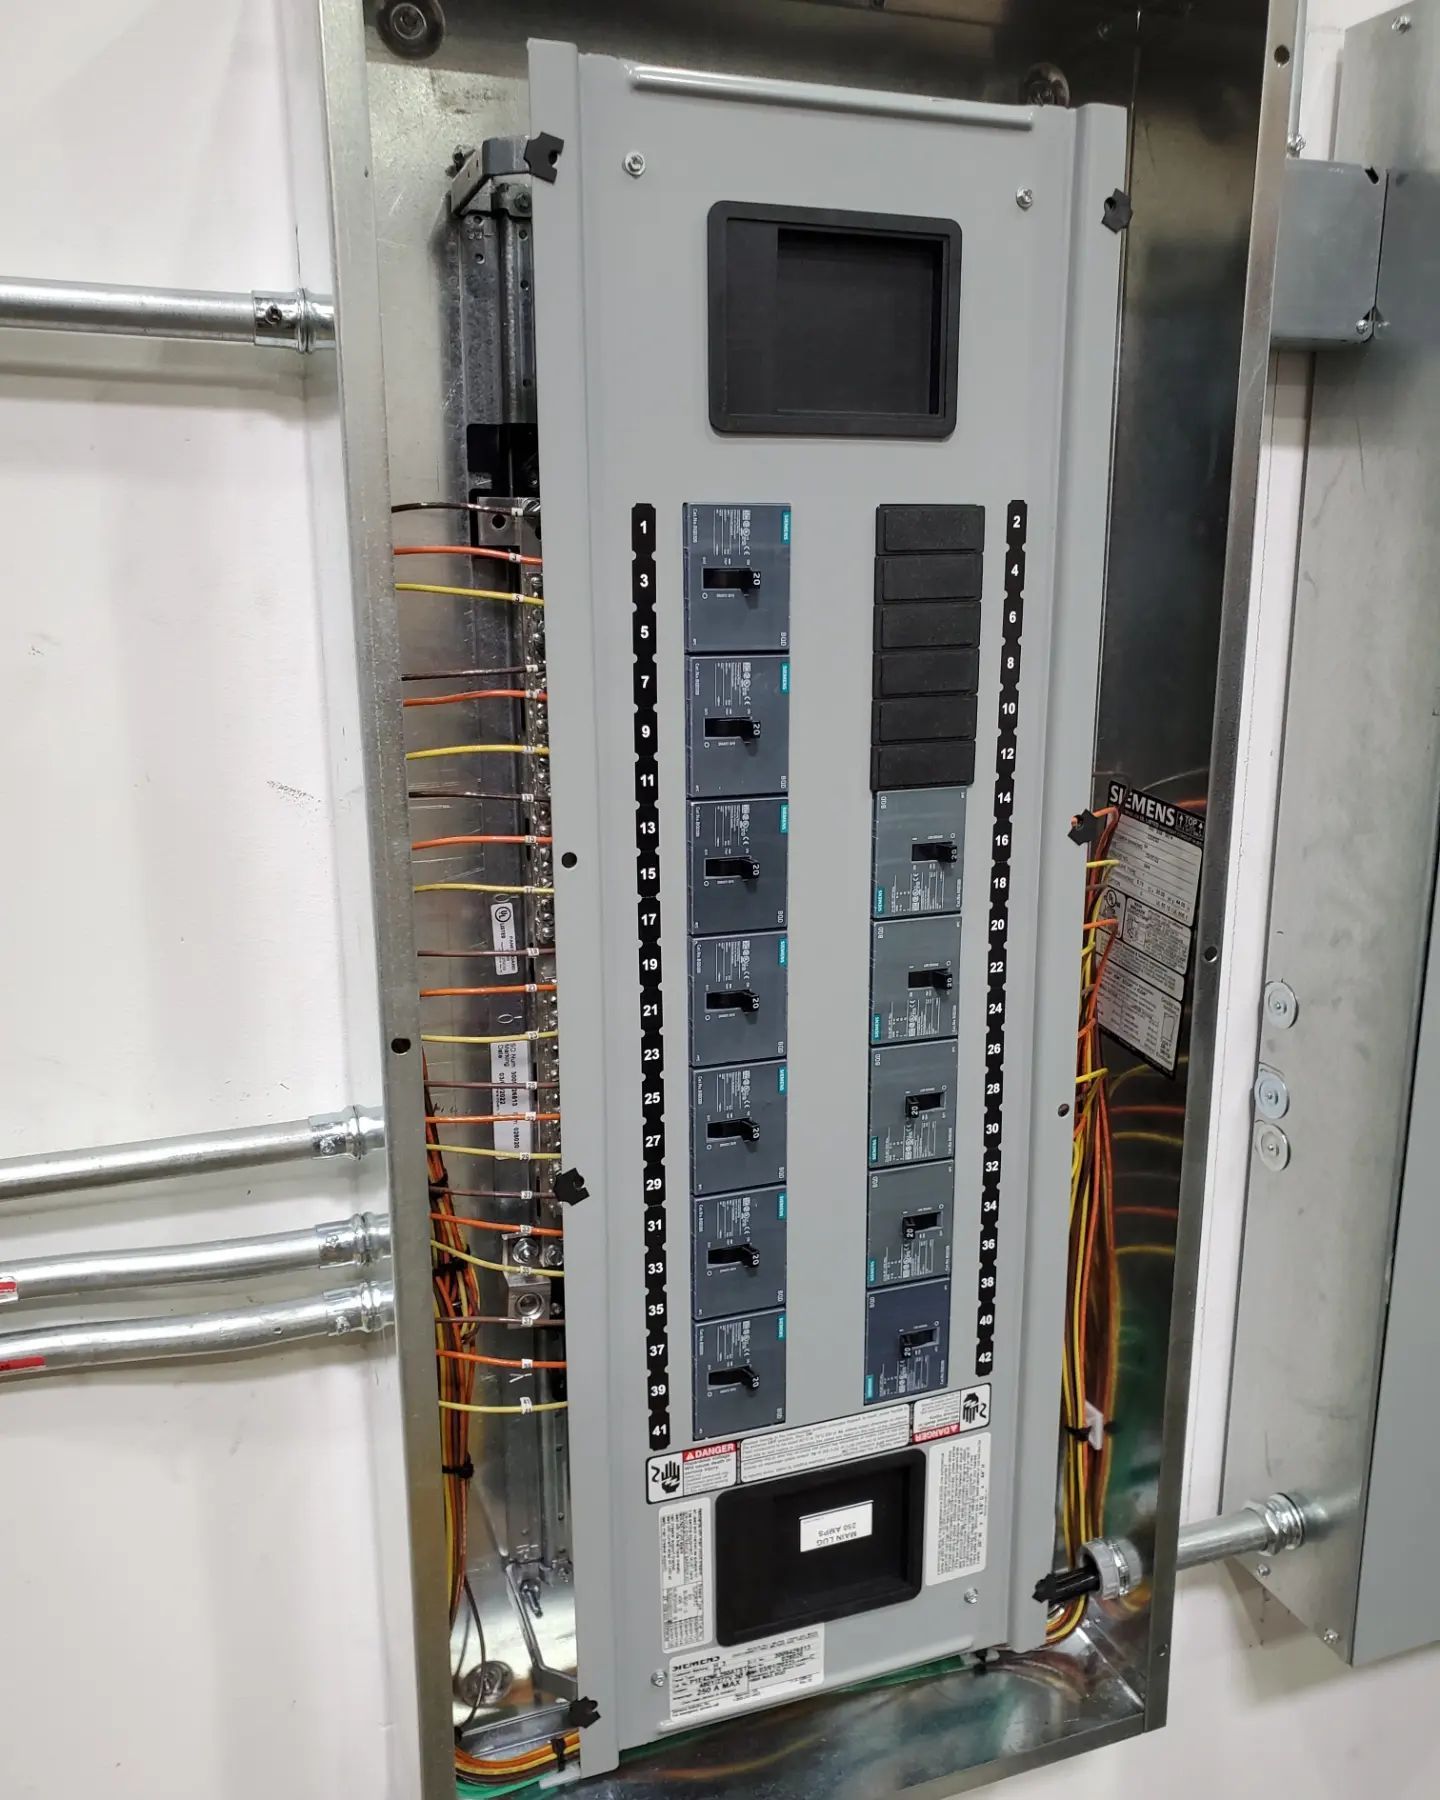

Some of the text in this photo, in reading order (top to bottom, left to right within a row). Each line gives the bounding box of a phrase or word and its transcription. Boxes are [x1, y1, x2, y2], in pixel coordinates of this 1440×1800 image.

[640, 520, 647, 534] 1
[1013, 515, 1021, 528] 2
[1011, 564, 1019, 576] 4
[640, 574, 649, 588] 3
[753, 573, 760, 585] 20
[1009, 610, 1016, 624] 6
[640, 625, 649, 639] 5
[1007, 656, 1014, 669] 8
[641, 675, 650, 688] 7
[1002, 702, 1016, 715] 10
[642, 725, 650, 738] 9
[754, 724, 760, 735] 20
[1000, 747, 1014, 760] 12
[640, 774, 654, 787] 11
[998, 792, 1011, 804] 14
[640, 821, 656, 834] 13
[995, 834, 1009, 846] 16
[640, 867, 656, 880] 15
[753, 864, 759, 875] 20
[993, 877, 1006, 889] 18
[641, 913, 657, 926] 17
[990, 919, 1005, 931] 20
[642, 958, 658, 971] 19
[990, 961, 1004, 973] 22
[947, 978, 952, 987] 20
[753, 998, 759, 1008] 20
[988, 1002, 1002, 1014] 24
[643, 1004, 658, 1016] 21
[644, 1048, 660, 1061] 23
[987, 1043, 1001, 1055] 26
[986, 1082, 1000, 1095] 28
[644, 1092, 660, 1105] 25
[911, 1106, 918, 1115] 20
[753, 1128, 759, 1138] 20
[986, 1122, 999, 1134] 30
[645, 1134, 661, 1148] 27
[985, 1160, 999, 1172] 32
[646, 1178, 662, 1191] 29
[984, 1200, 997, 1212] 34
[648, 1219, 662, 1232] 31
[907, 1229, 913, 1237] 20
[982, 1238, 995, 1250] 36
[753, 1255, 759, 1265] 20
[648, 1262, 664, 1274] 33
[981, 1276, 994, 1288] 38
[648, 1303, 664, 1316] 35
[979, 1314, 993, 1326] 40
[650, 1344, 665, 1356] 37
[904, 1348, 911, 1356] 20
[978, 1352, 992, 1363] 42
[753, 1377, 758, 1387] 20
[651, 1384, 666, 1396] 39
[652, 1424, 666, 1436] 41
[915, 1426, 950, 1442] DANGER
[695, 1443, 734, 1457] DANGER
[818, 1527, 841, 1536] AMPS
[817, 1531, 857, 1546] MAIN LUG
